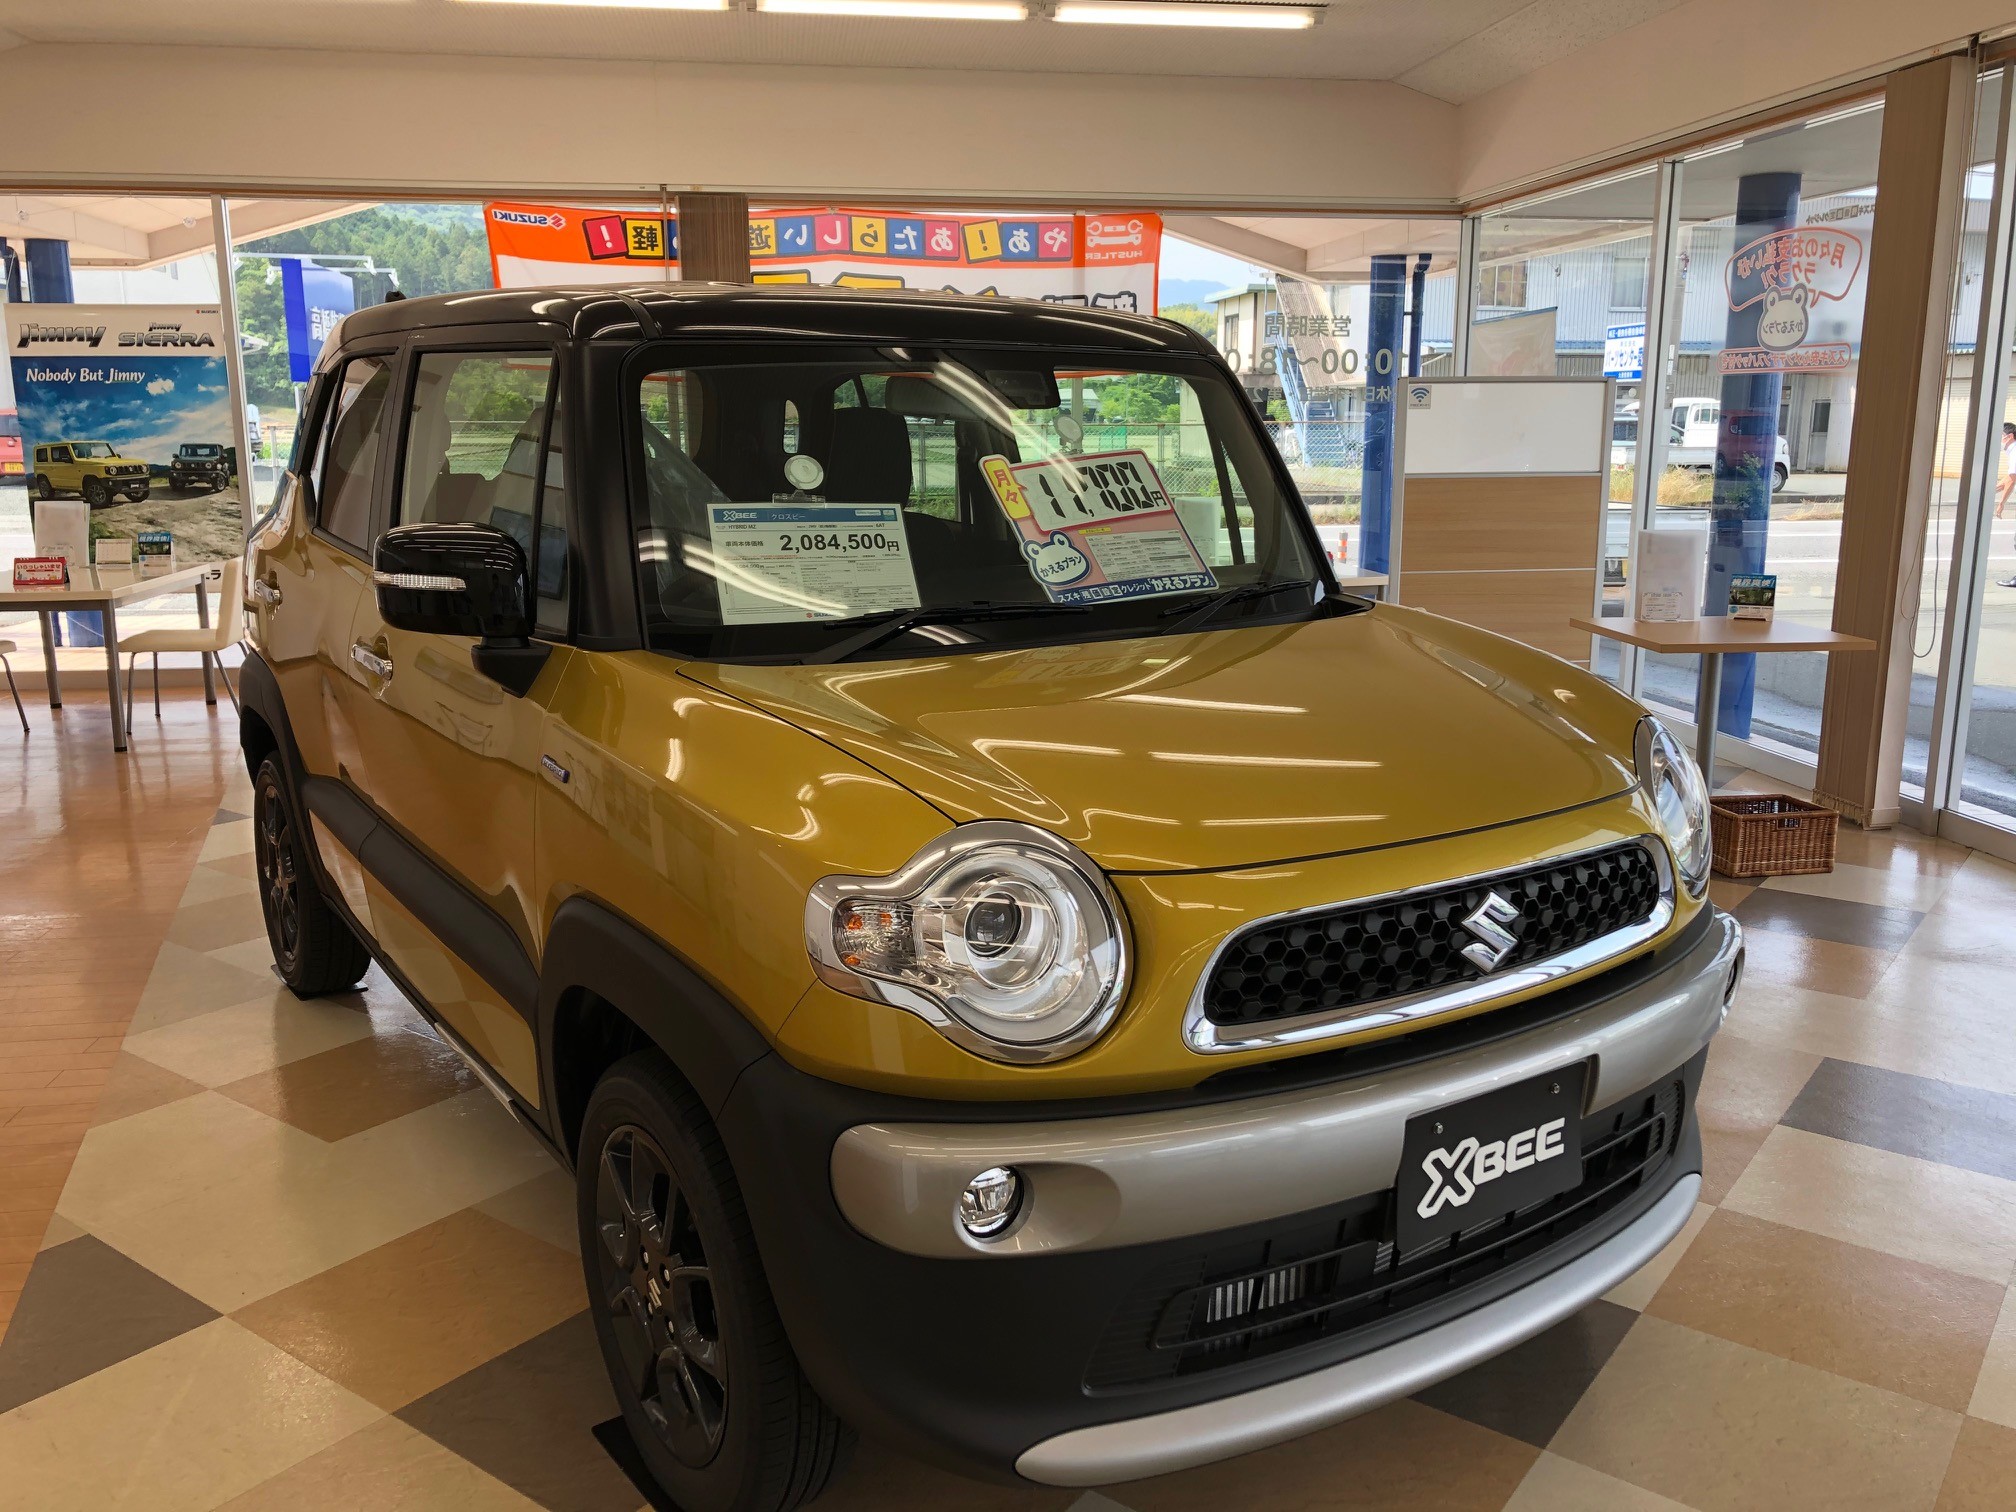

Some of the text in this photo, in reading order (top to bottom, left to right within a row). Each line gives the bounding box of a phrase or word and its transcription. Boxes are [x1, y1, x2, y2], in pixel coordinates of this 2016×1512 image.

[17, 323, 106, 348] Jimny
[118, 332, 215, 347] SIERRA
[26, 368, 145, 383] Nobody But Jimny
[994, 469, 1018, 504] 月々
[723, 510, 757, 521] XBEE
[779, 533, 900, 553] 2,084,500円
[1040, 555, 1082, 578] かえるプラン
[1416, 1117, 1565, 1219] XBEE
